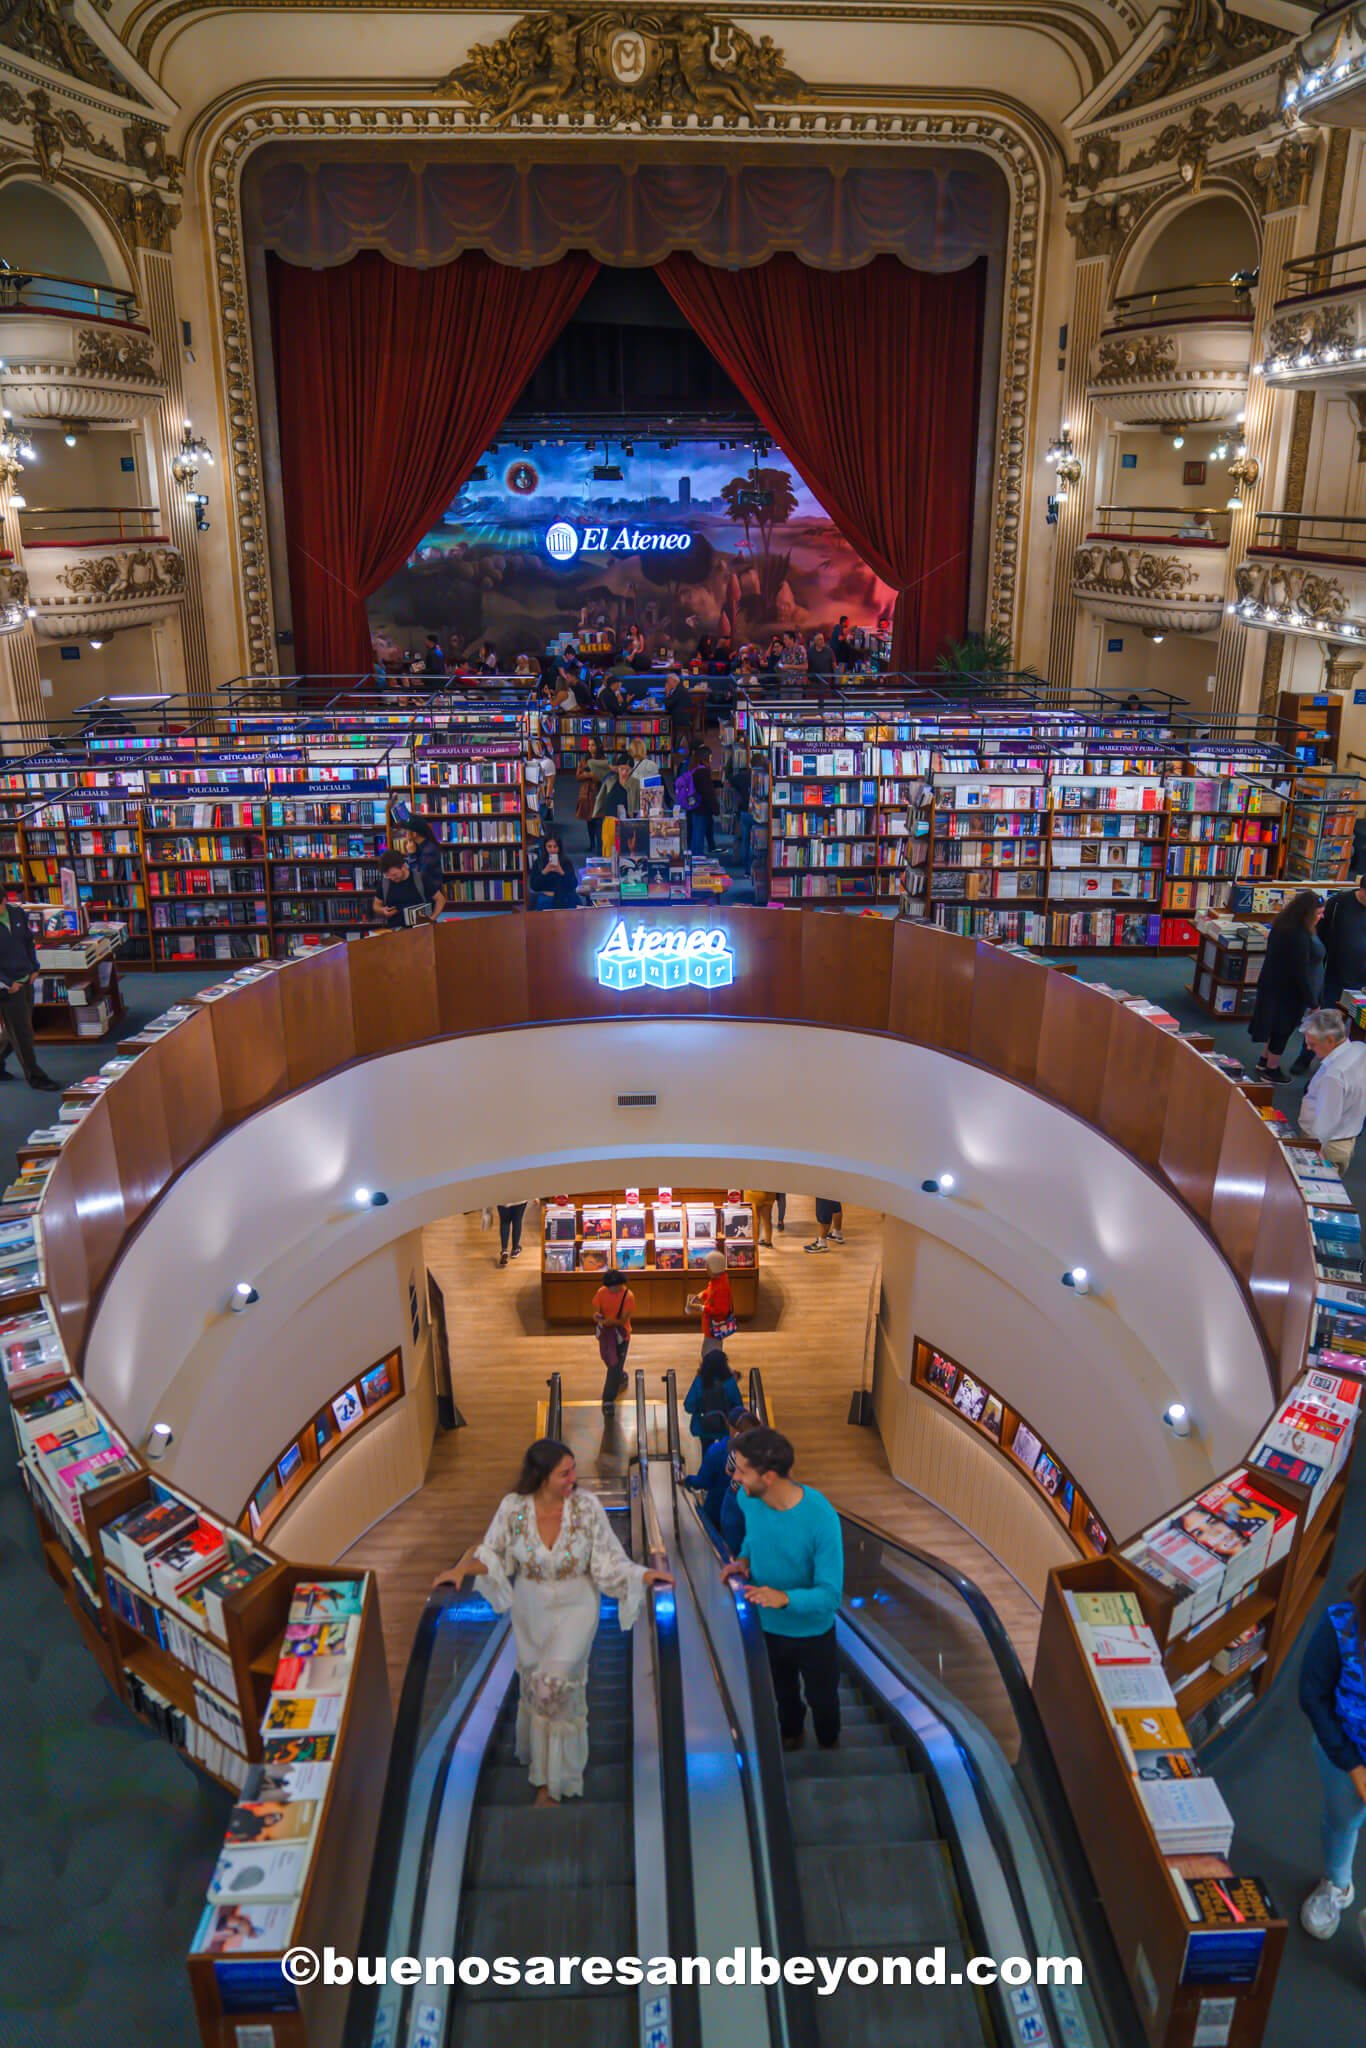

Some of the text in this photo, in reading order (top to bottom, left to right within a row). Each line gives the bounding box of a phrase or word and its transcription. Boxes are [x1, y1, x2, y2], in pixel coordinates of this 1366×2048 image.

[580, 527, 691, 551] El Ateneo
[604, 920, 727, 952] Ateneo
